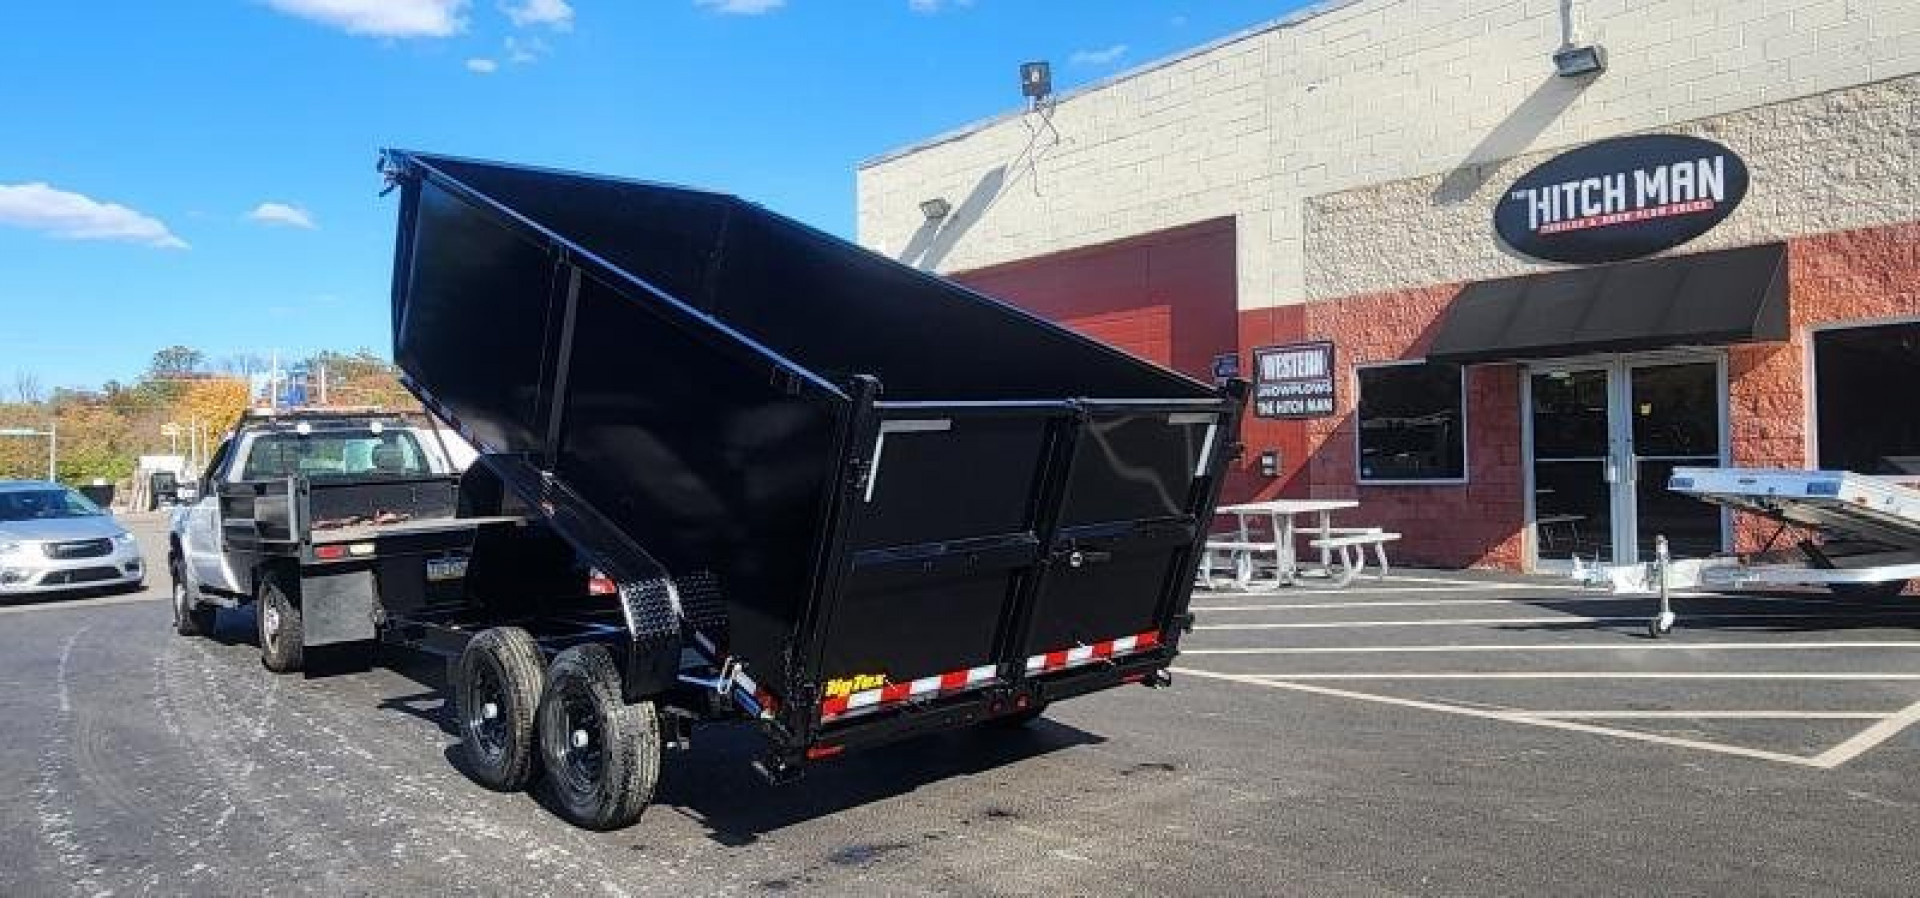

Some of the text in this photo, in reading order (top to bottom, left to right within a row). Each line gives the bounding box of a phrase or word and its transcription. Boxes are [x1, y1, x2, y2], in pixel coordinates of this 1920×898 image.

[1528, 172, 1626, 230] HITCH
[1633, 155, 1724, 207] MAN
[1262, 350, 1323, 380] WESTERN
[1276, 399, 1305, 414] HITCH
[1307, 398, 1332, 412] MAN
